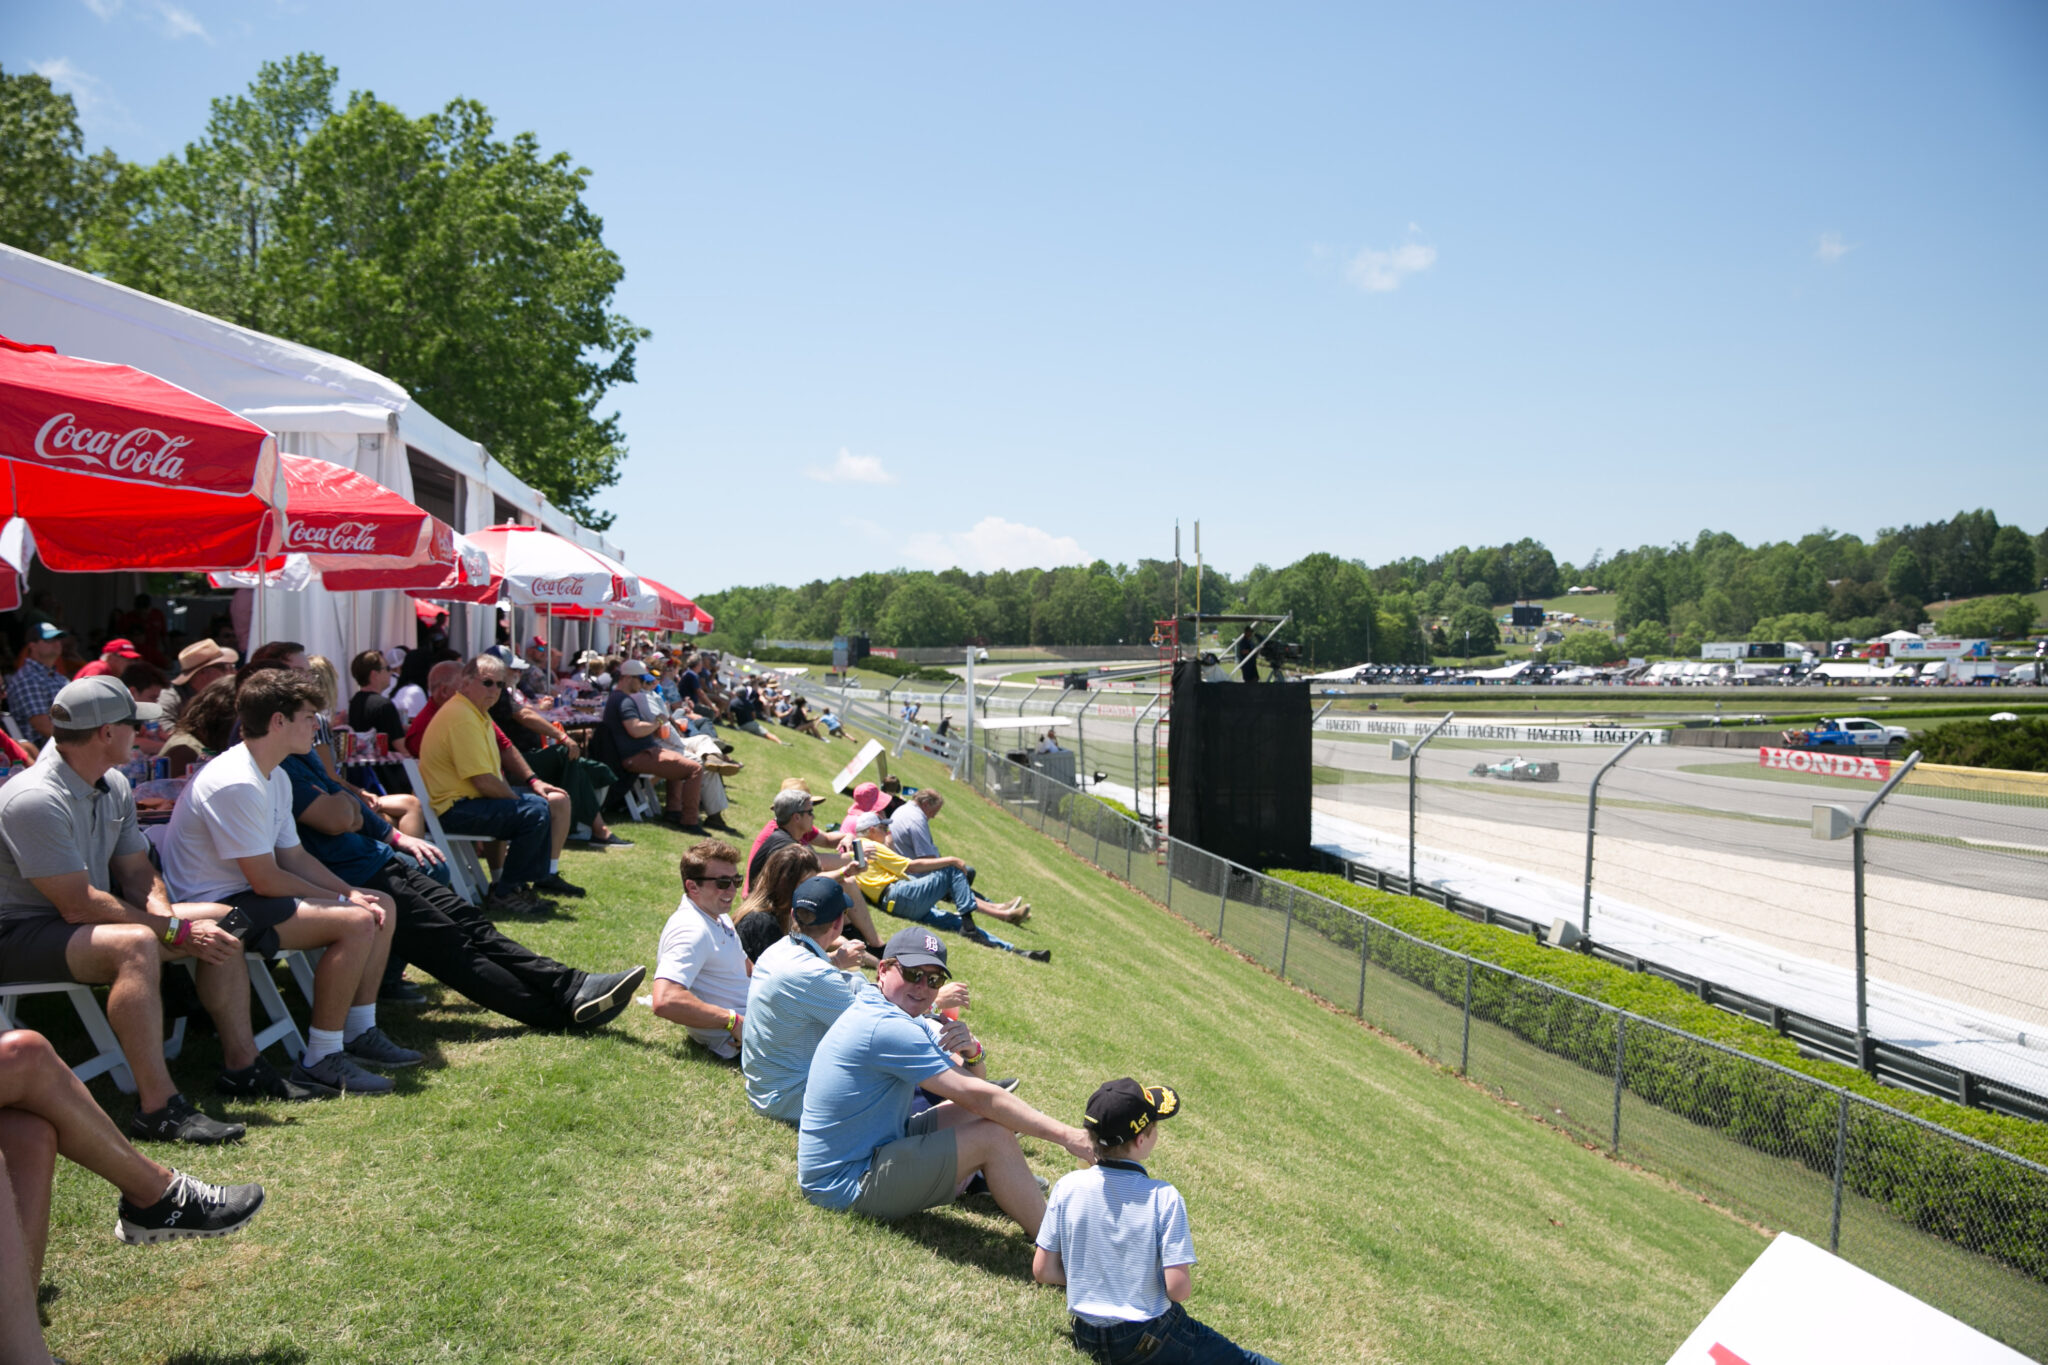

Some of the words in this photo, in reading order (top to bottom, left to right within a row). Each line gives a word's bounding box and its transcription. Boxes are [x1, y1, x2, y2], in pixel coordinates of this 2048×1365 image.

[34, 412, 195, 480] Coca-Cola
[285, 520, 379, 551] Coca-Cola
[531, 576, 585, 596] Coca-Cola
[1326, 719, 1360, 732] HAGERTY
[1367, 722, 1407, 735] HAGERTY
[1467, 725, 1518, 739] HAGERTY
[1528, 728, 1583, 741] HAGERTY
[1594, 730, 1653, 744] HAGERY
[1765, 750, 1883, 780] HONDA
